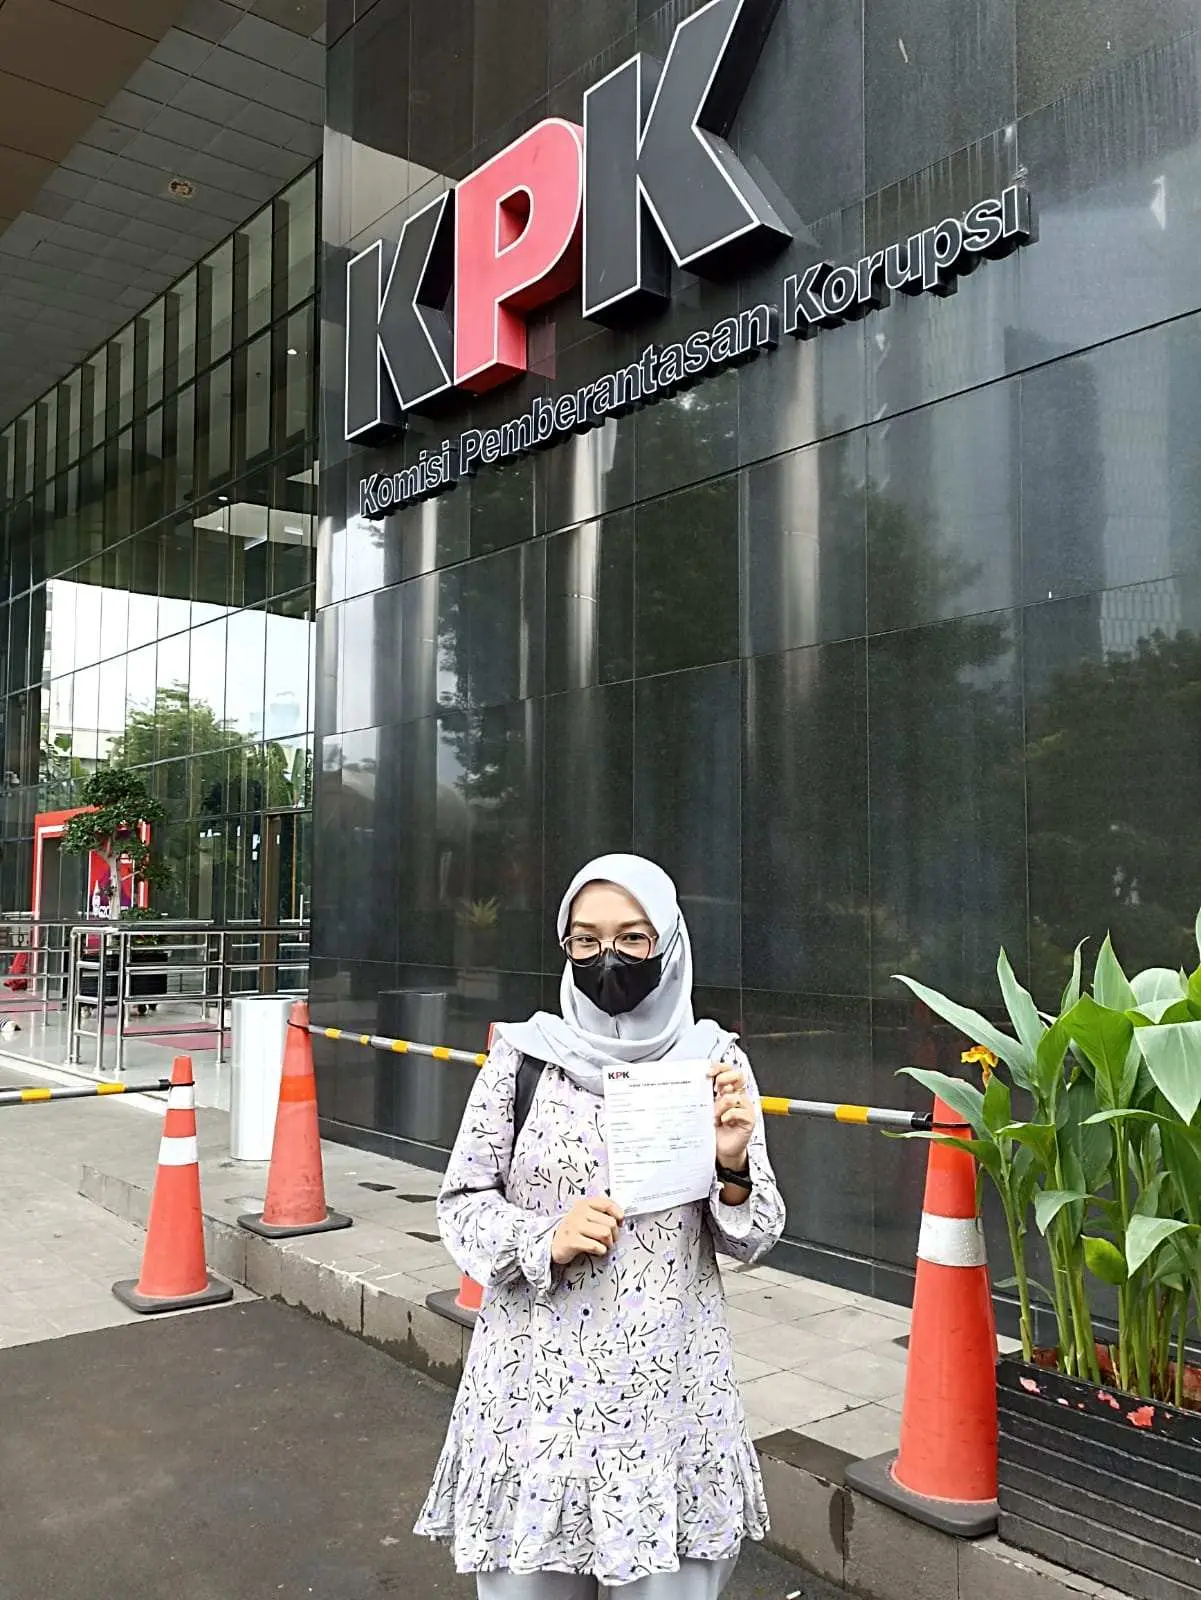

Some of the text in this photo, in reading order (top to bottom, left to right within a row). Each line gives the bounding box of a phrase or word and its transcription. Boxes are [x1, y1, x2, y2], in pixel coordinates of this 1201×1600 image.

[345, 0, 764, 441] KPK
[359, 185, 1019, 518] Komisi Pemberantasan Korupsi
[607, 1071, 630, 1080] KPK
